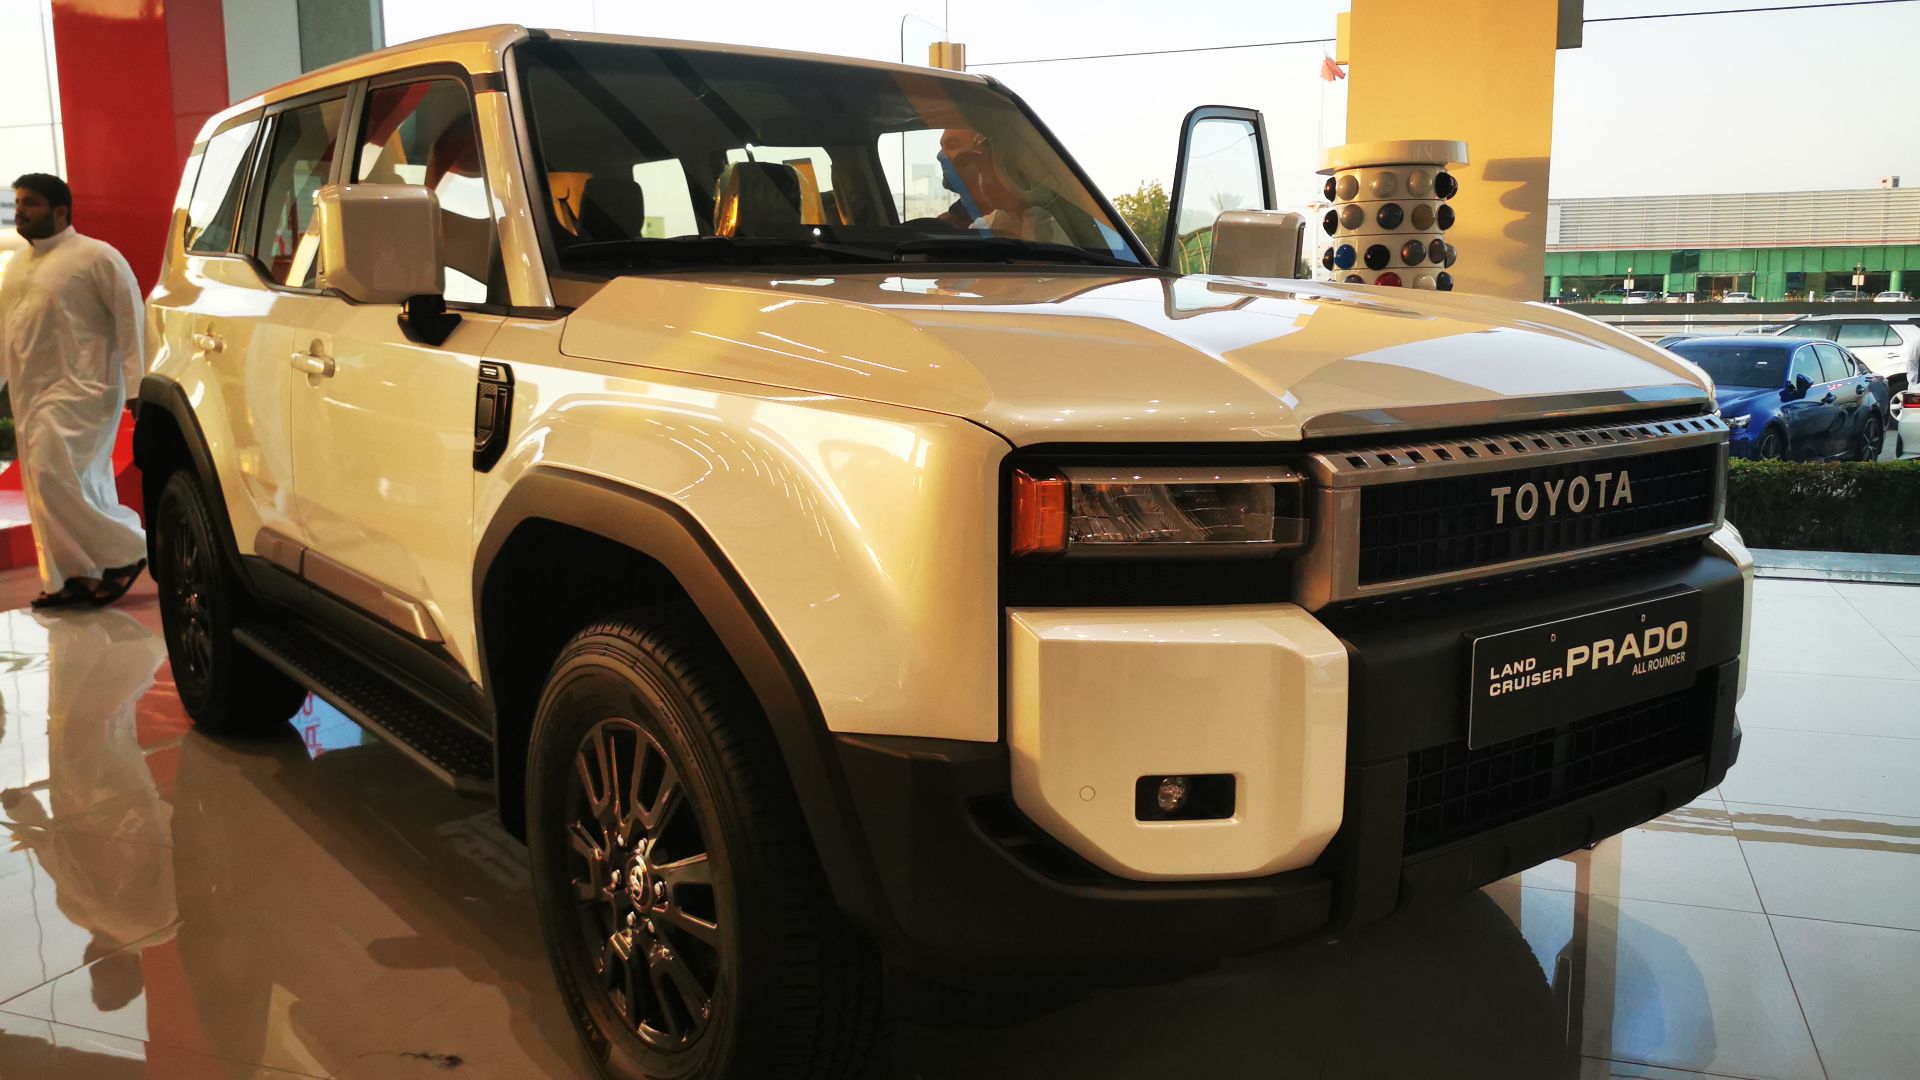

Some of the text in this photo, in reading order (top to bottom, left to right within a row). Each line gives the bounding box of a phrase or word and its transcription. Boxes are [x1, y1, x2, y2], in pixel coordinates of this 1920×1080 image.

[1491, 470, 1633, 524] TOYOTA
[1489, 620, 1688, 697] CRUISER PRADO
[1490, 657, 1536, 680] LAND
[1632, 651, 1686, 676] ALL ROUNDER
